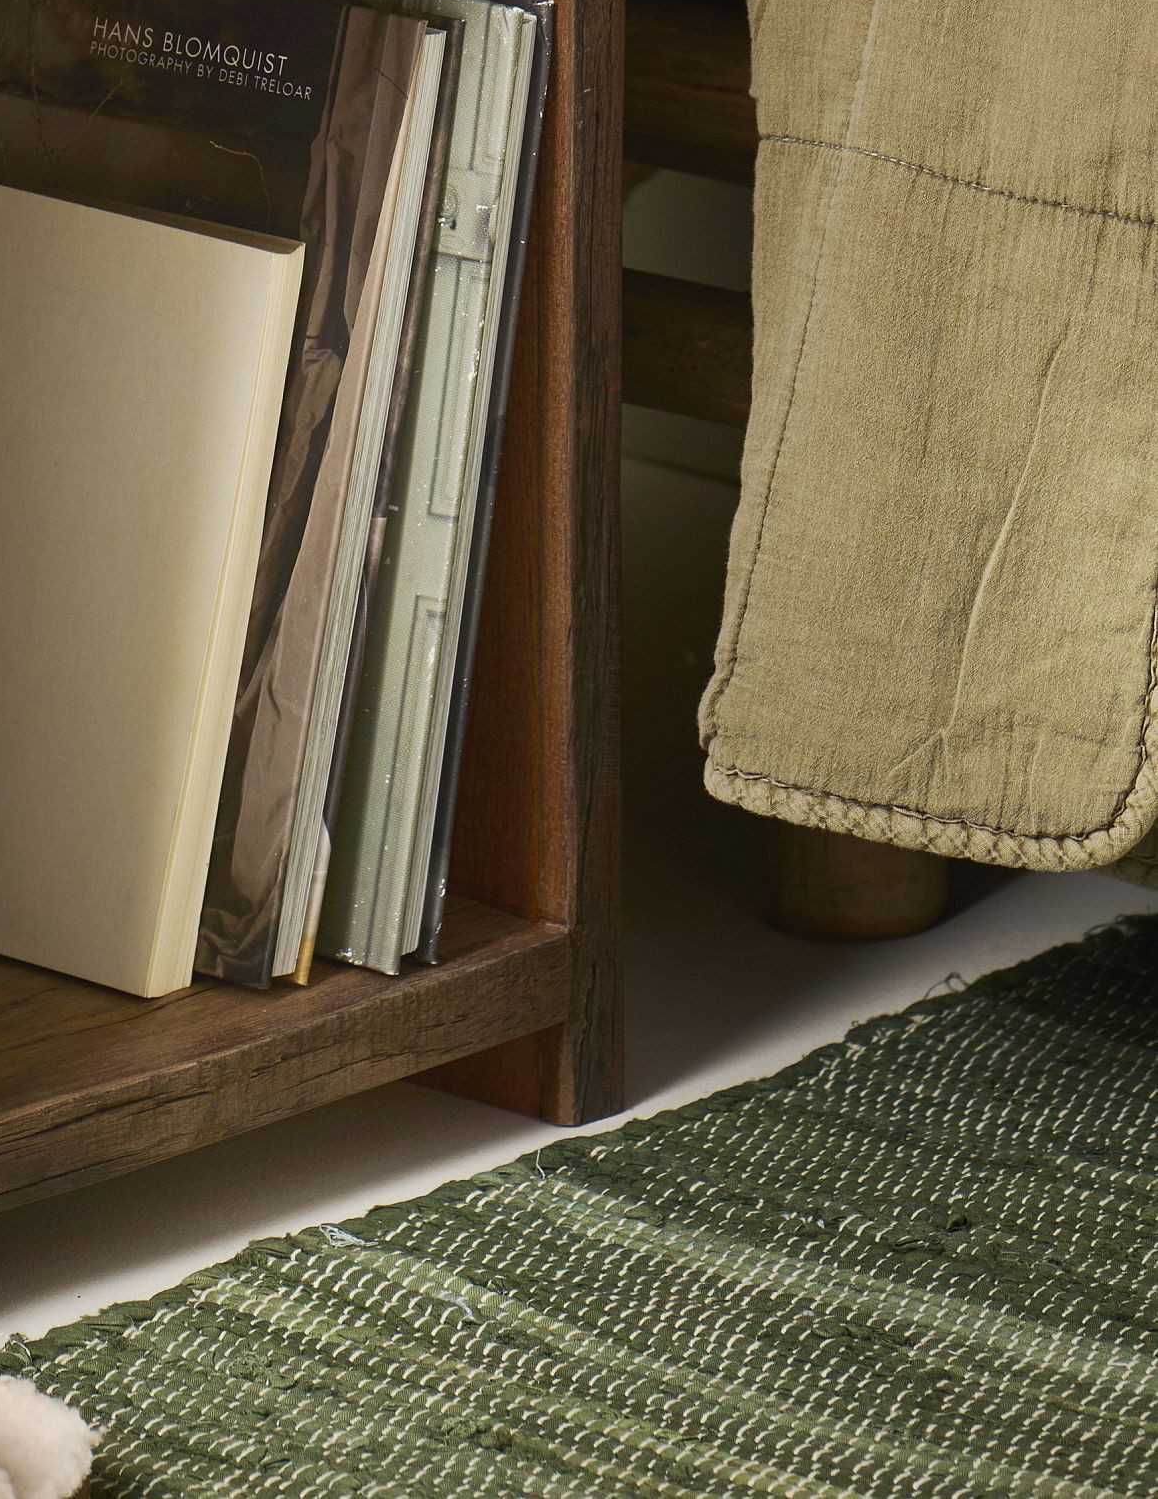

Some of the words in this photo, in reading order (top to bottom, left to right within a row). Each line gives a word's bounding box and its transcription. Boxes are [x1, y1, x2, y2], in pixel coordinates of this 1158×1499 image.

[89, 41, 192, 75] PHOTOGRAPHY
[196, 64, 213, 79] BY
[218, 68, 249, 86] DEBI
[253, 75, 313, 100] TRELOAR
[92, 16, 154, 49] HANS
[162, 32, 288, 76] BLOMQUIST
